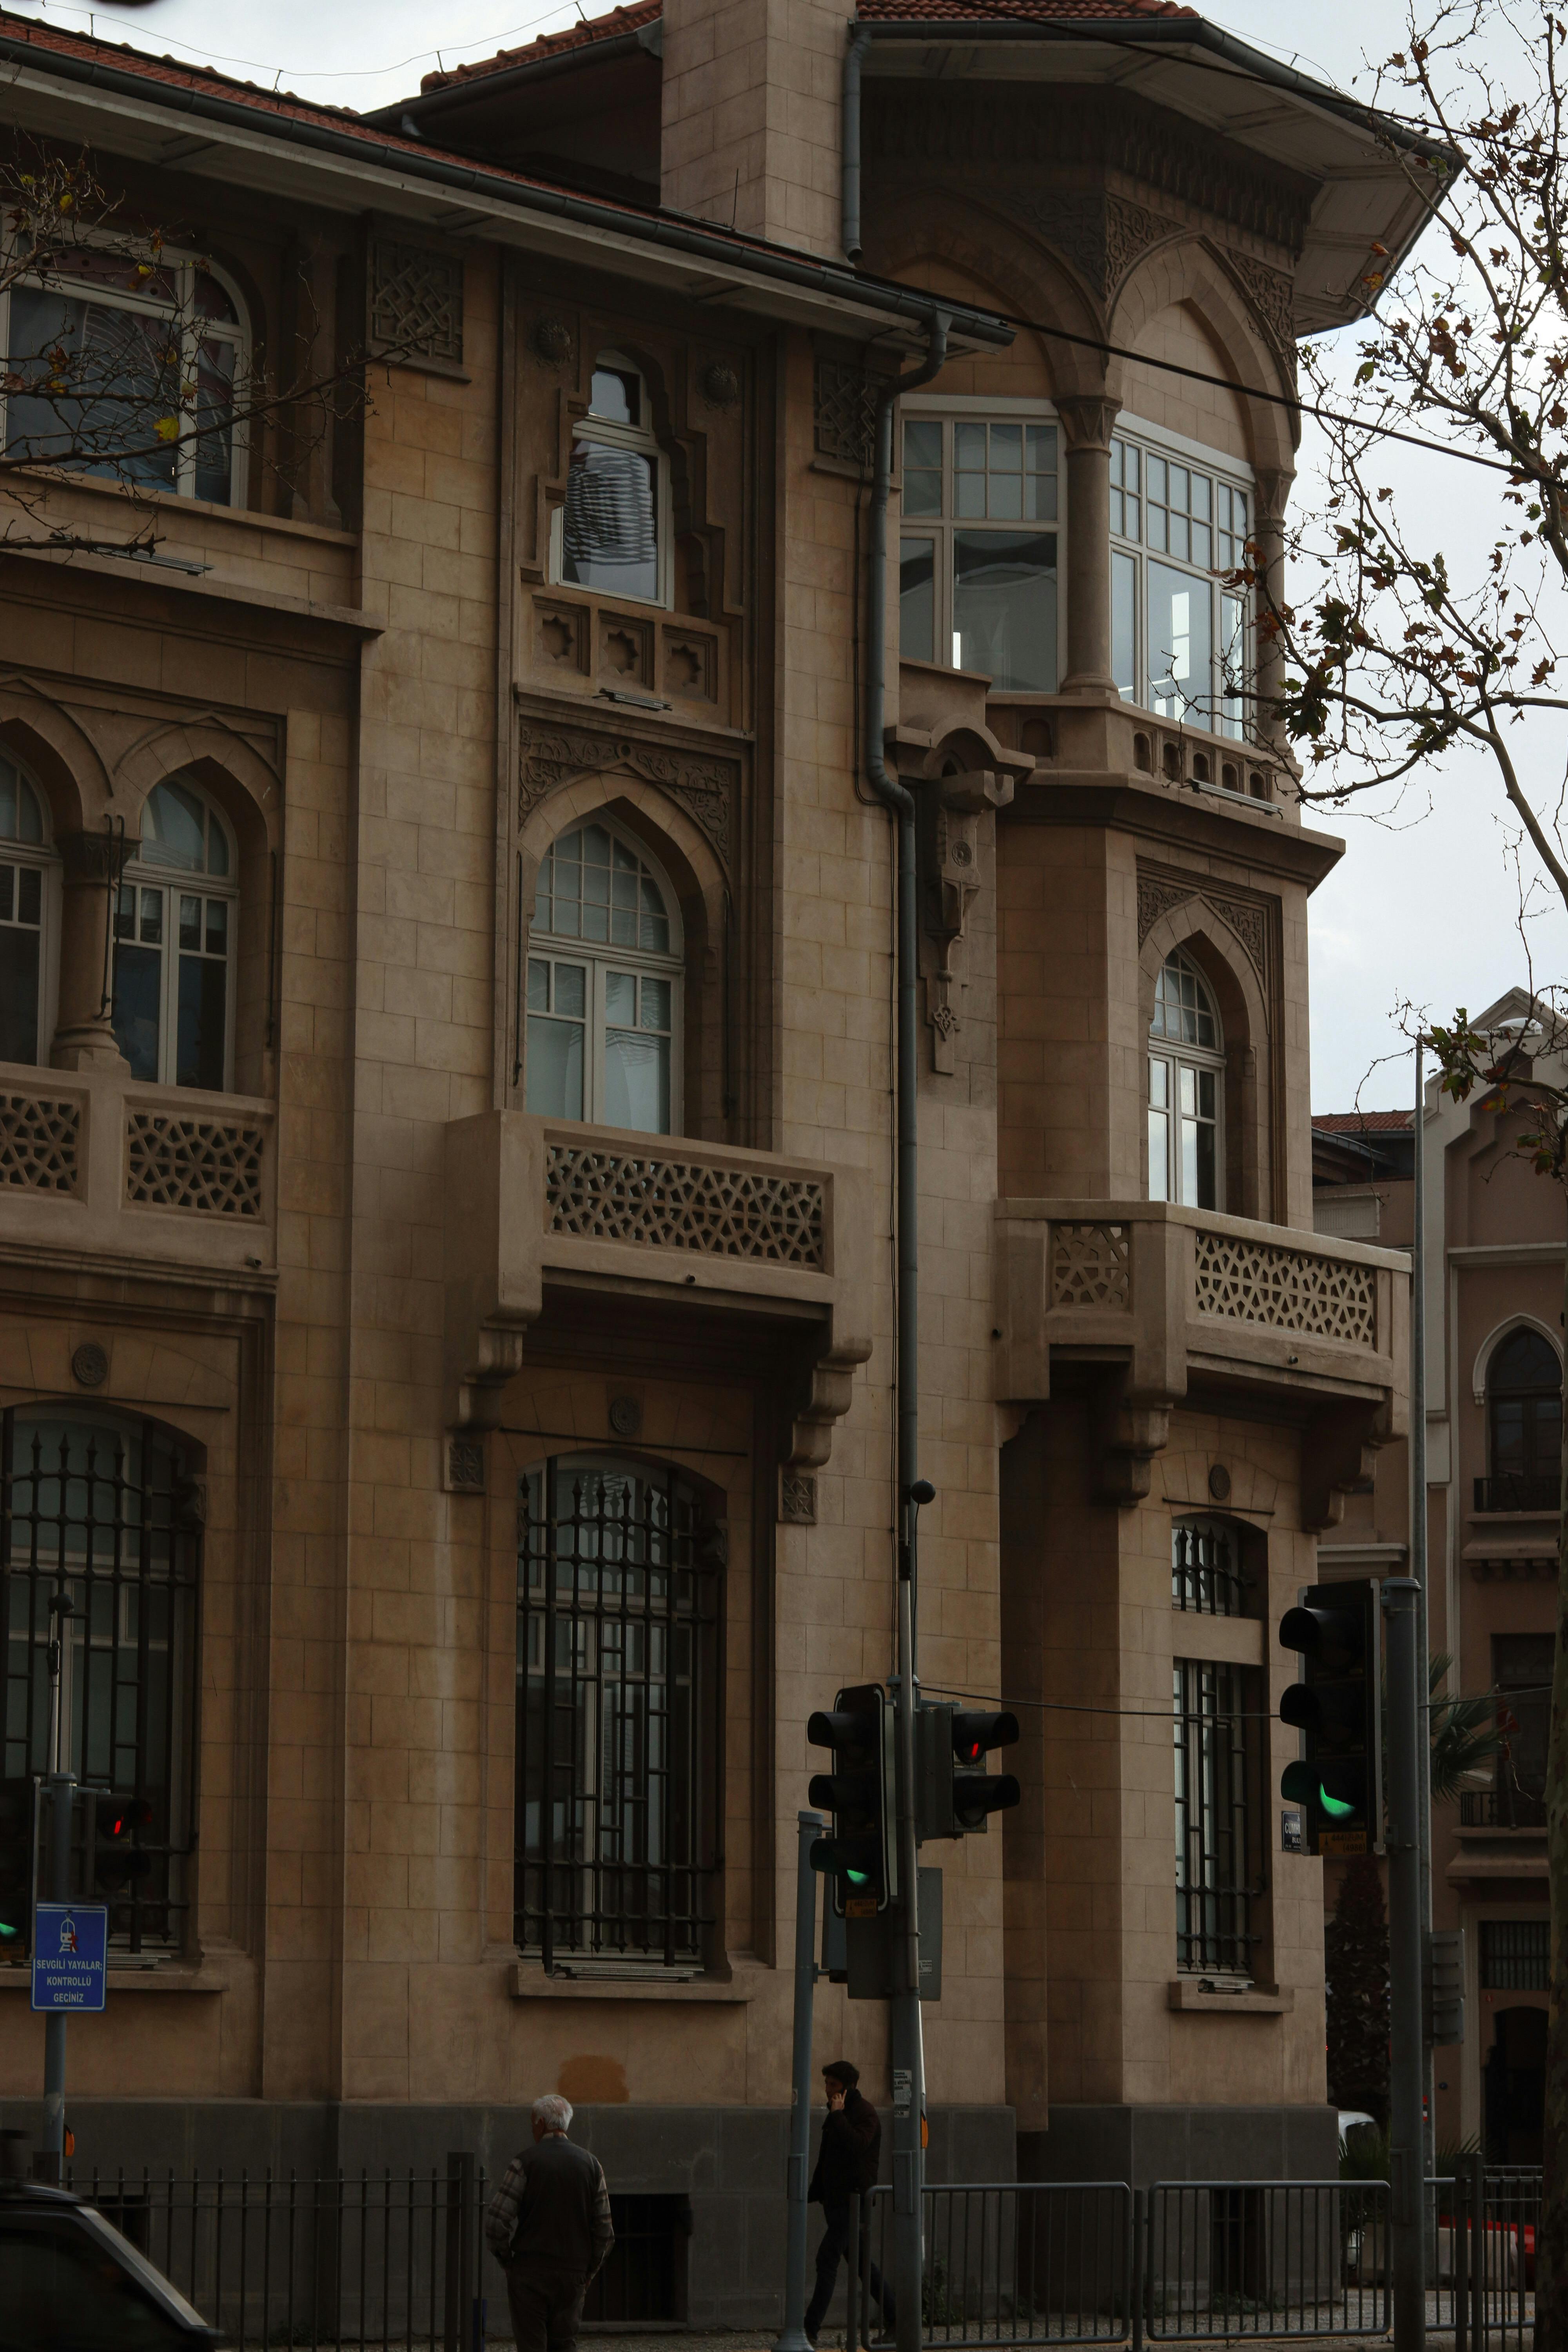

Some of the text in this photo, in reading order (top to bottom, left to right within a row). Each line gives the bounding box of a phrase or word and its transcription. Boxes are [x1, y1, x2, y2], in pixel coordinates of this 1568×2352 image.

[1343, 1842, 1365, 1853] (4986)
[37, 1958, 102, 1972] SEVGİLİ YAYALAR;
[47, 1975, 91, 1986] KONTROLLÜ
